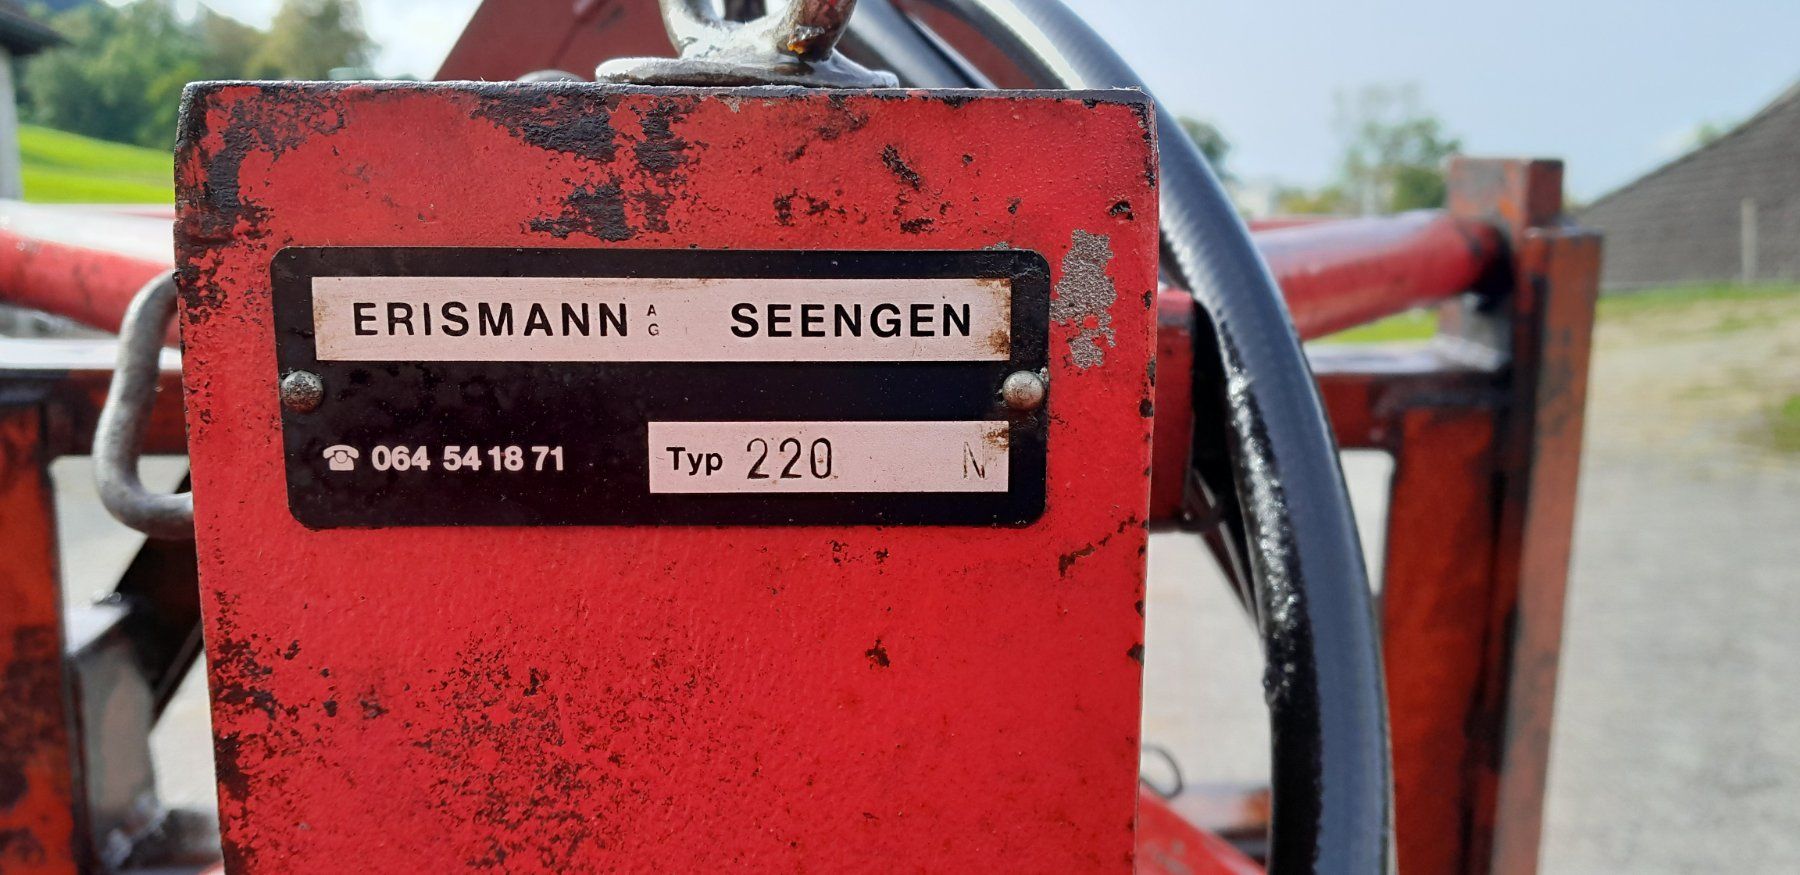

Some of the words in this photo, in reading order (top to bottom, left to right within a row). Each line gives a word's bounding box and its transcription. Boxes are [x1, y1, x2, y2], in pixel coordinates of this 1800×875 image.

[353, 301, 628, 337] ERISMANN
[730, 303, 970, 338] SEENGEN
[371, 445, 431, 471] 064
[443, 445, 482, 471] 54
[487, 445, 524, 471] 18
[531, 445, 564, 471] 71
[666, 446, 723, 476] Typ
[746, 437, 833, 480] 220
